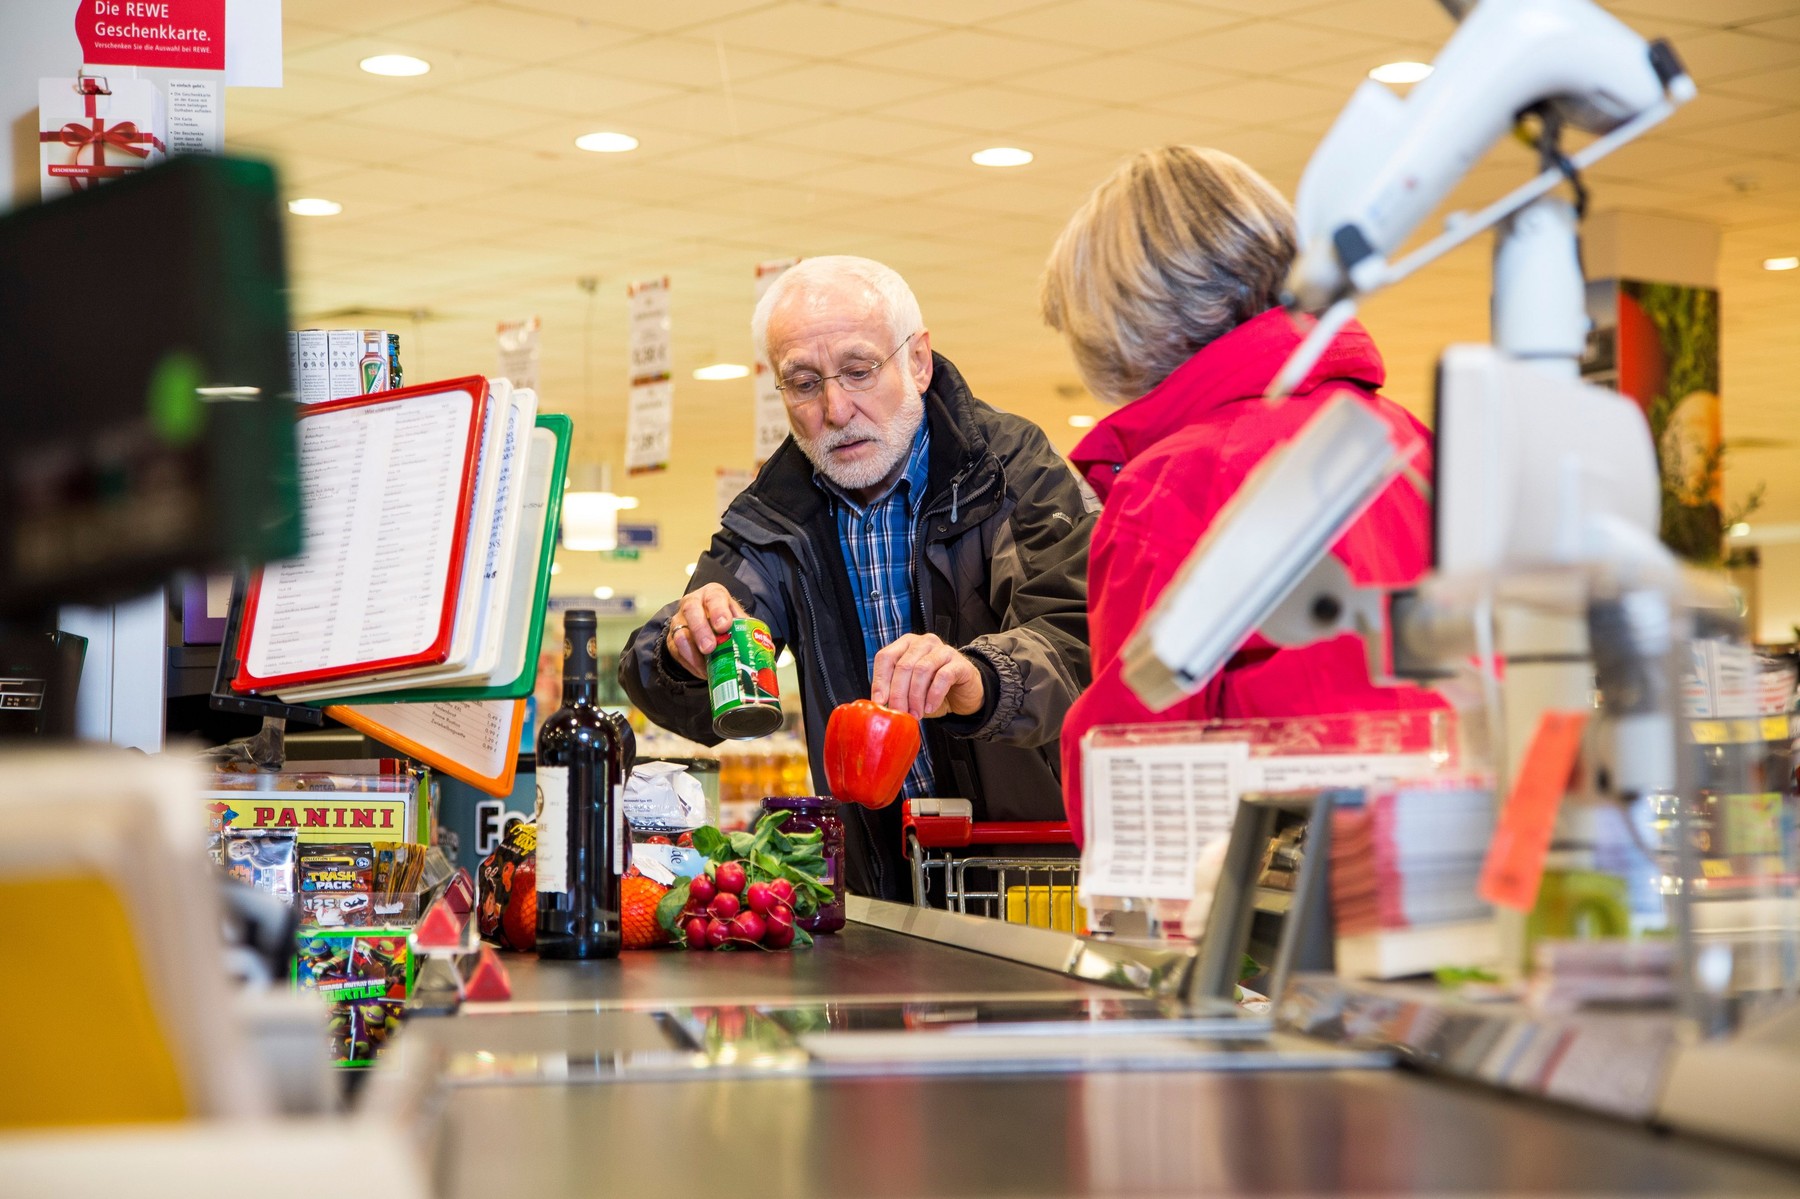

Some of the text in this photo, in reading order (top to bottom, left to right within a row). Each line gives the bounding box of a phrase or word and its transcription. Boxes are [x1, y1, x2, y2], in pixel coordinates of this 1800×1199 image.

[95, 1, 169, 18] Die REWE
[95, 21, 211, 41] Geschenkkarte.
[94, 42, 132, 50] Verschenken
[155, 44, 180, 52] Auswahl
[253, 807, 394, 828] PANINI
[308, 871, 357, 883] TRASH
[315, 881, 353, 890] PACK
[320, 984, 387, 1003] TURTLES
